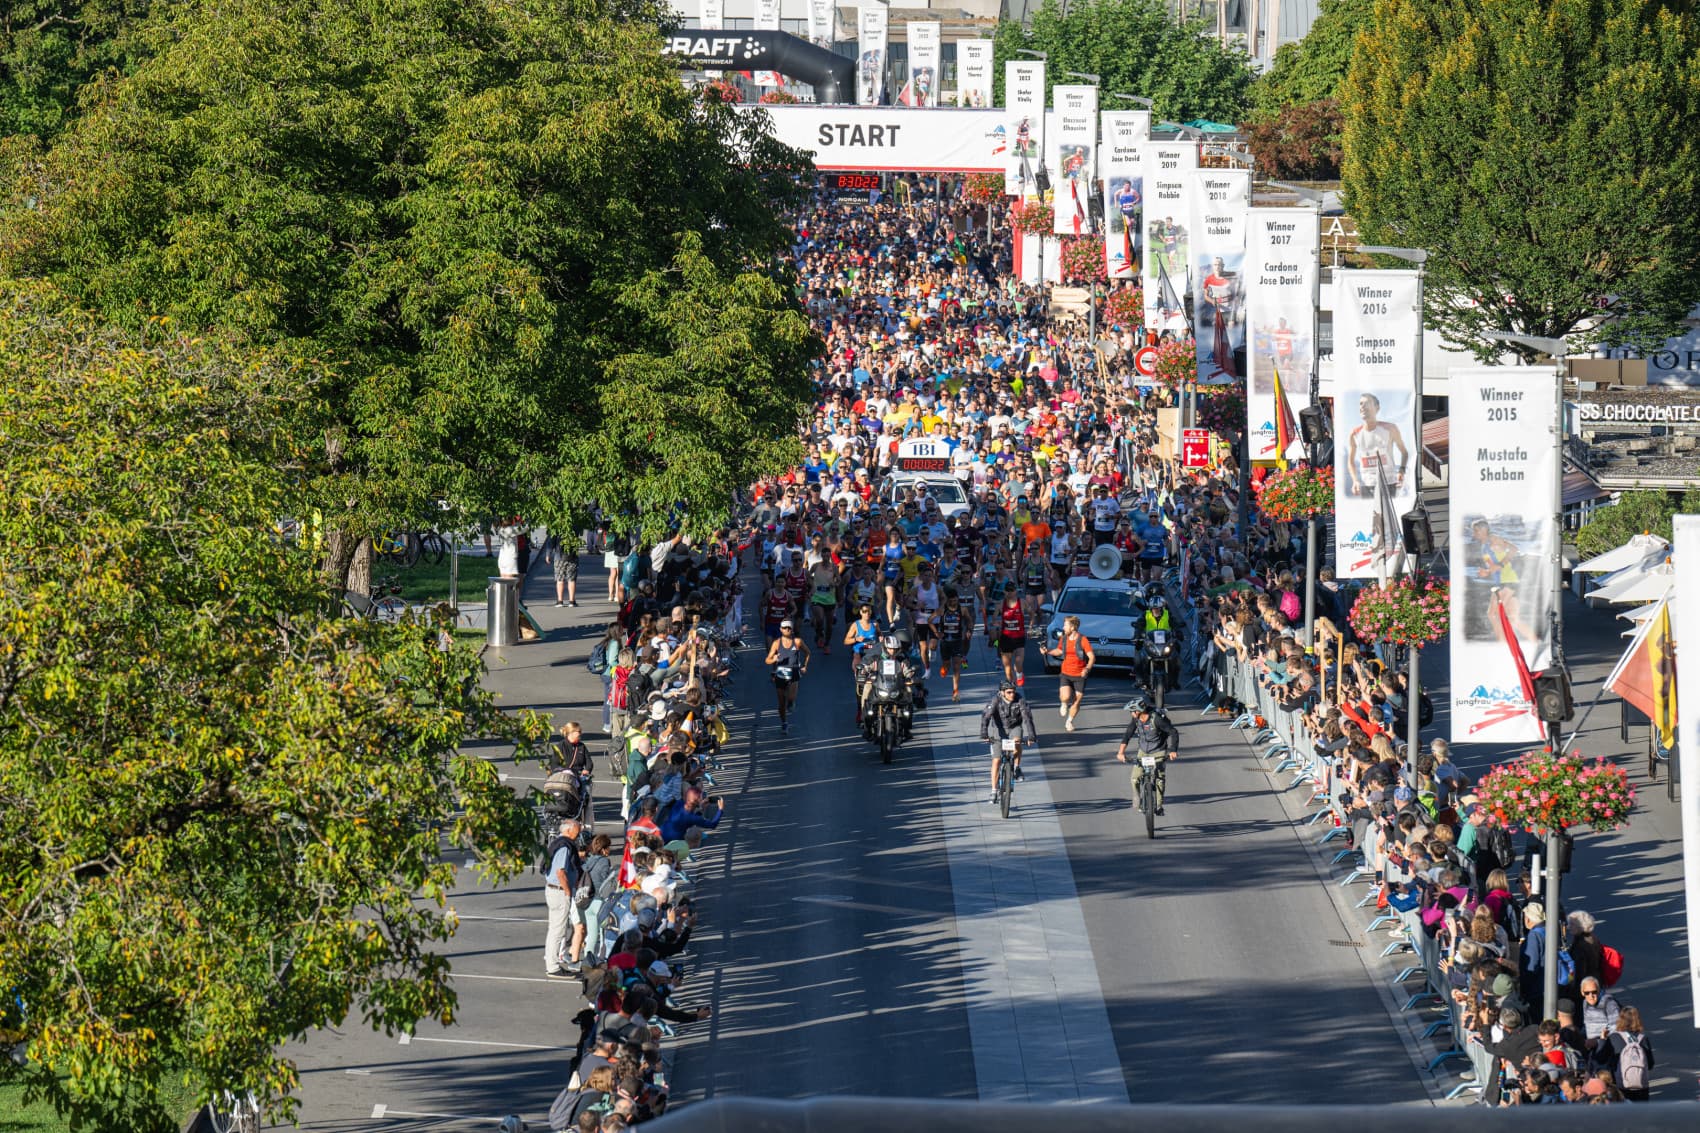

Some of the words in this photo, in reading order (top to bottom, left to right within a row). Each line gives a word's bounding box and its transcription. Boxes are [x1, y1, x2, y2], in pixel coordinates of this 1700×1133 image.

[1115, 119, 1135, 127] Winner
[818, 123, 901, 147] START
[1124, 154, 1140, 162] David
[1158, 151, 1181, 159] Winner
[1161, 161, 1177, 169] 2019
[1156, 181, 1182, 190] Simpson
[1205, 180, 1231, 189] Winner
[1158, 191, 1181, 199] Robbie
[1209, 192, 1227, 200] 2018
[1204, 215, 1233, 225] Simpson
[1207, 226, 1232, 235] Robbie
[1266, 221, 1296, 231] Winner
[1271, 235, 1291, 245] 2017
[1264, 262, 1298, 272] Cardona
[1259, 275, 1277, 285] Jose
[1279, 275, 1303, 285] David
[1357, 286, 1393, 300] Winner
[1363, 302, 1387, 315] 2016
[1355, 335, 1396, 351] Simpson
[1359, 350, 1393, 365] Robbie
[1480, 388, 1524, 402] Winner
[1487, 407, 1517, 422] 2015
[1604, 404, 1690, 421] CHOCOLATE
[913, 443, 935, 456] IBI
[1477, 447, 1528, 462] Mustafa
[1480, 466, 1525, 481] Shaban
[1455, 697, 1492, 706] jungfrau
